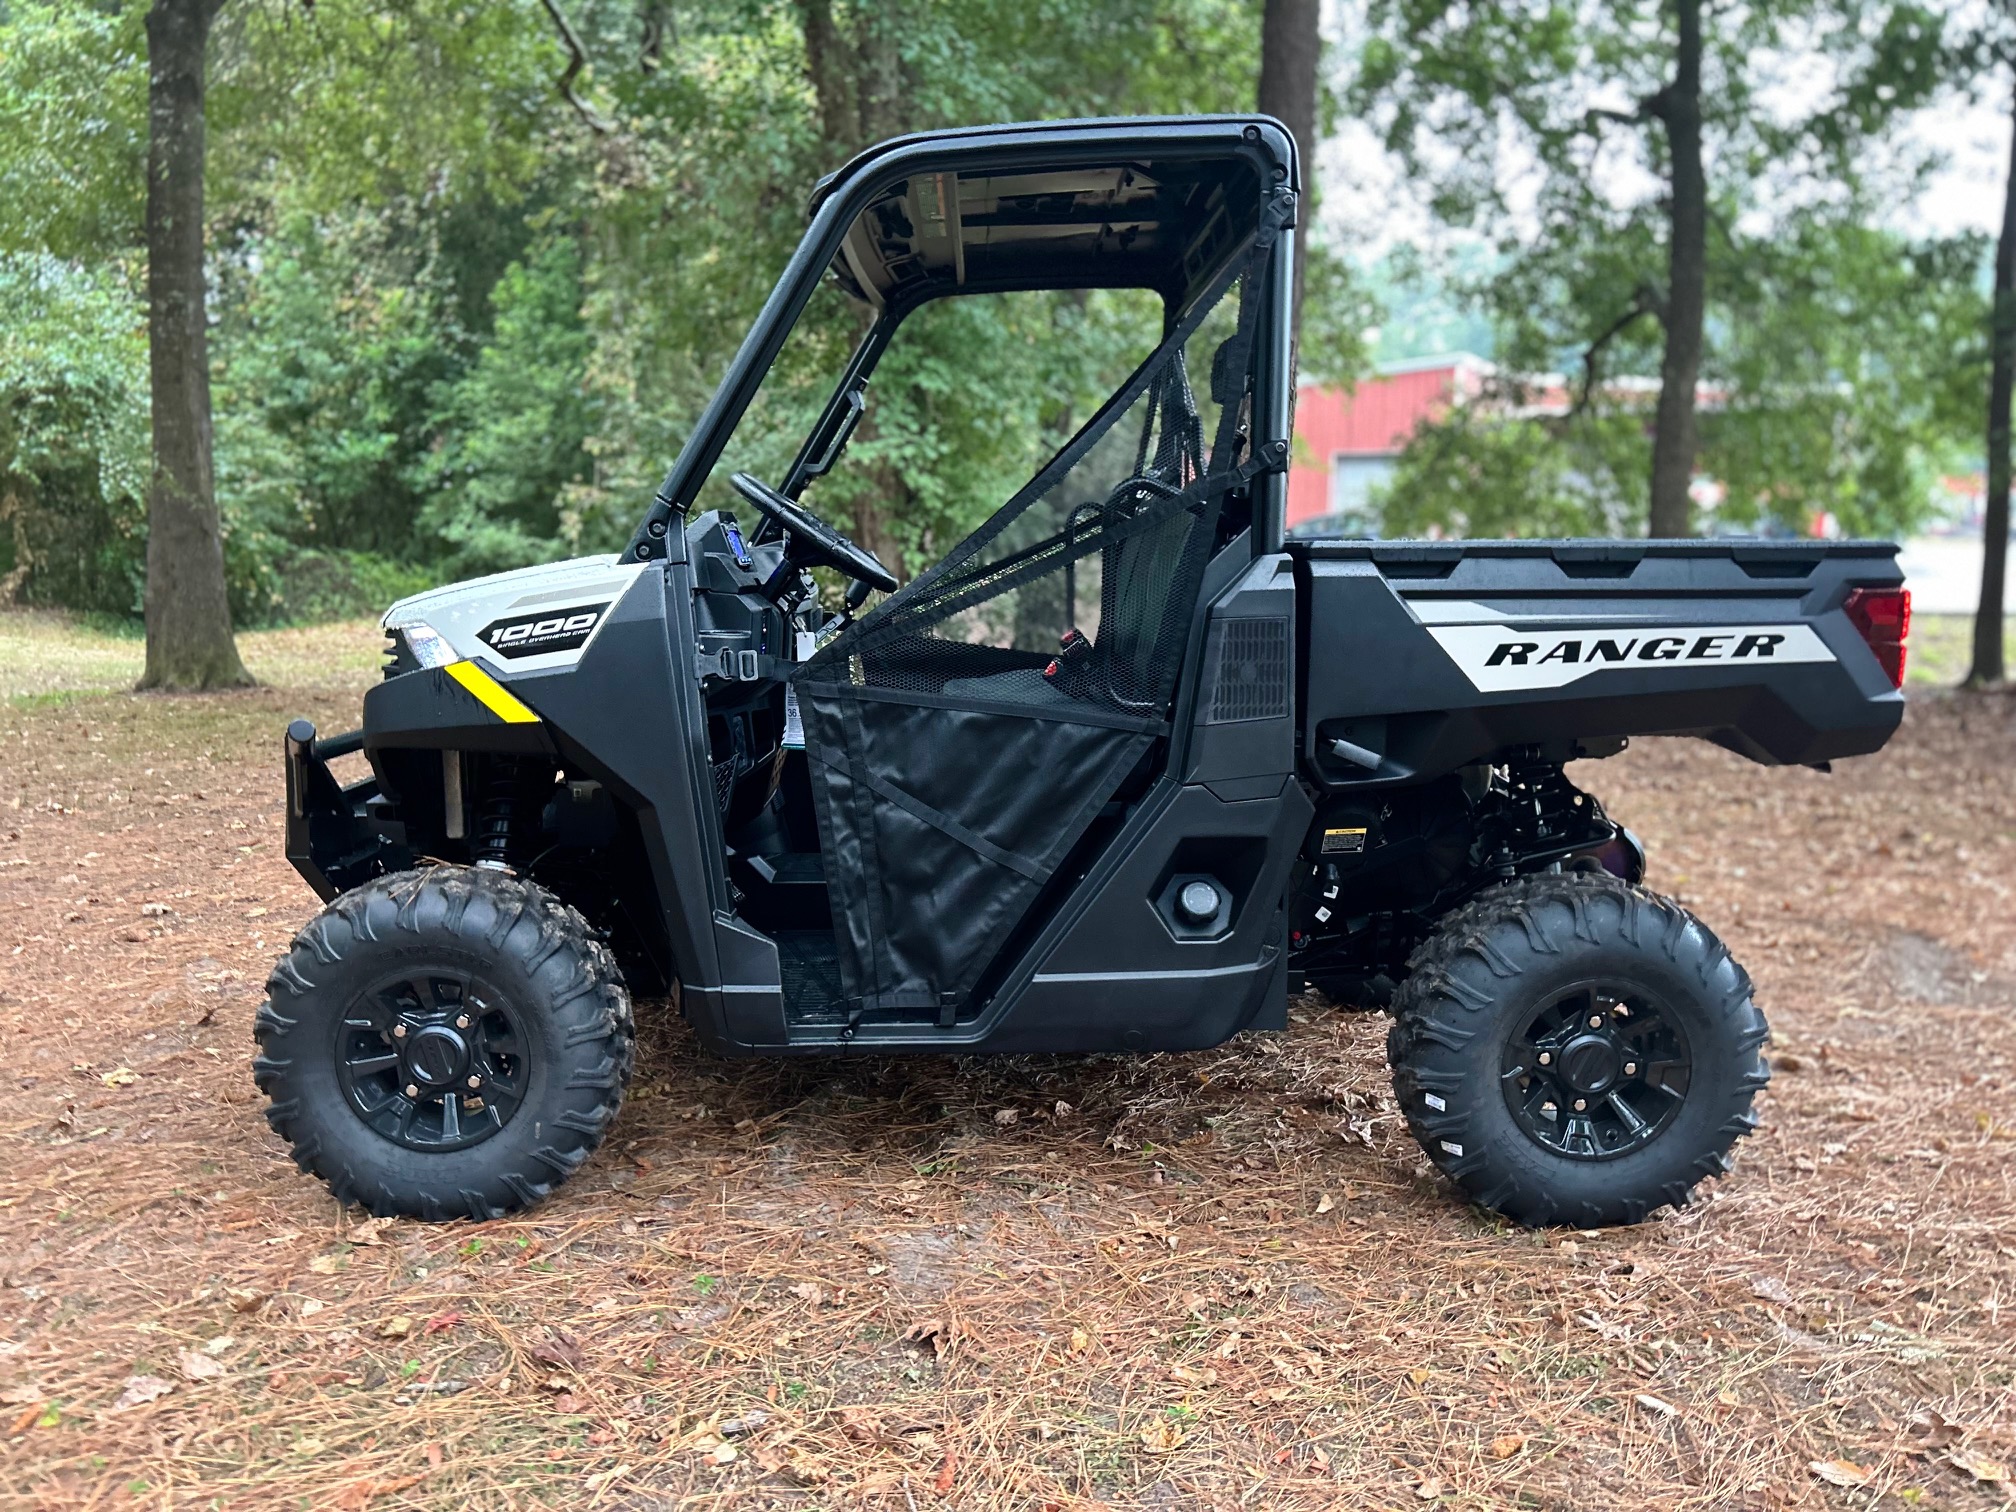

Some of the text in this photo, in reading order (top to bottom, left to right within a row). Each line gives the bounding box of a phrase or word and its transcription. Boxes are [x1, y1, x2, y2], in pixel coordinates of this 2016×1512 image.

[490, 612, 598, 644] 1000
[497, 628, 591, 649] SINGLE OVERHEAD CAM
[1483, 634, 1786, 666] RANGER
